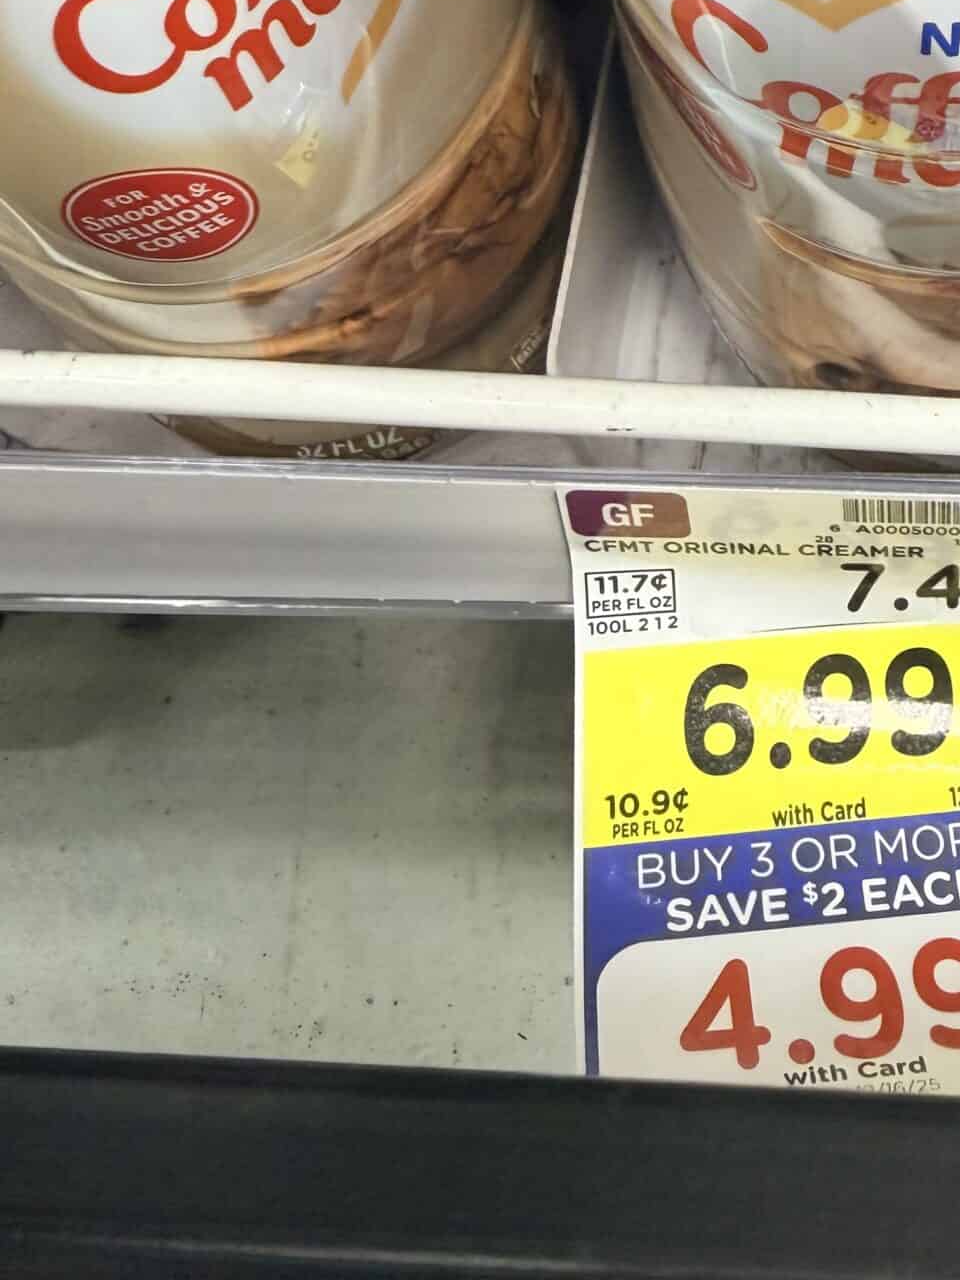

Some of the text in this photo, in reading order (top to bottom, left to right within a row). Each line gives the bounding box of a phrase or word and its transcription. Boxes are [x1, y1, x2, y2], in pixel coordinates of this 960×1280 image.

[81, 182, 213, 232] Smooth &
[102, 190, 150, 208] FOR
[98, 191, 236, 244] DELICIOUS
[135, 213, 236, 252] COFFEE
[601, 503, 655, 528] GF
[829, 524, 841, 533] 6
[584, 540, 925, 559] CFMT ORIGINAL CREAMER
[593, 573, 668, 595] 11.7¢
[592, 595, 673, 613] PER FL OZ
[683, 647, 955, 777] 6.99
[604, 788, 689, 819] 10.9¢
[772, 798, 867, 828] with Card
[611, 817, 685, 838] PER FL OZ
[636, 846, 733, 889] BUY
[750, 842, 774, 878] 3
[791, 834, 859, 872] OR
[665, 888, 790, 932] SAVE
[802, 881, 848, 918] $2
[783, 1056, 928, 1086] with Card
